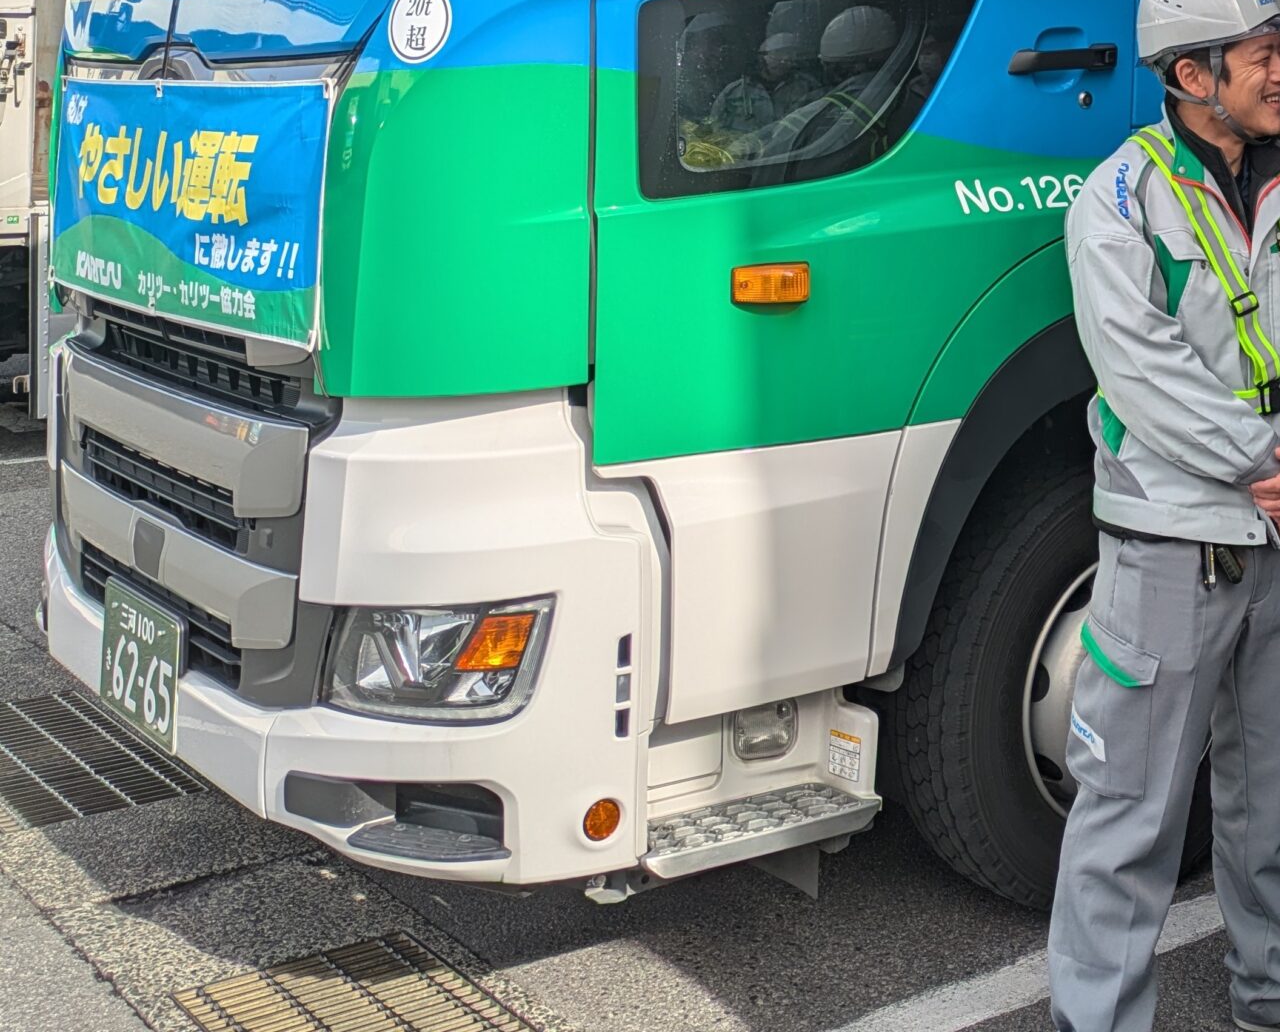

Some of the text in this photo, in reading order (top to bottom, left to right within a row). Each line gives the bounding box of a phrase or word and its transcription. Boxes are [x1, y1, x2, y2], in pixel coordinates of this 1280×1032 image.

[405, 24, 428, 51] 超
[79, 122, 259, 226] やさしい運転
[112, 634, 173, 735] 62-65
